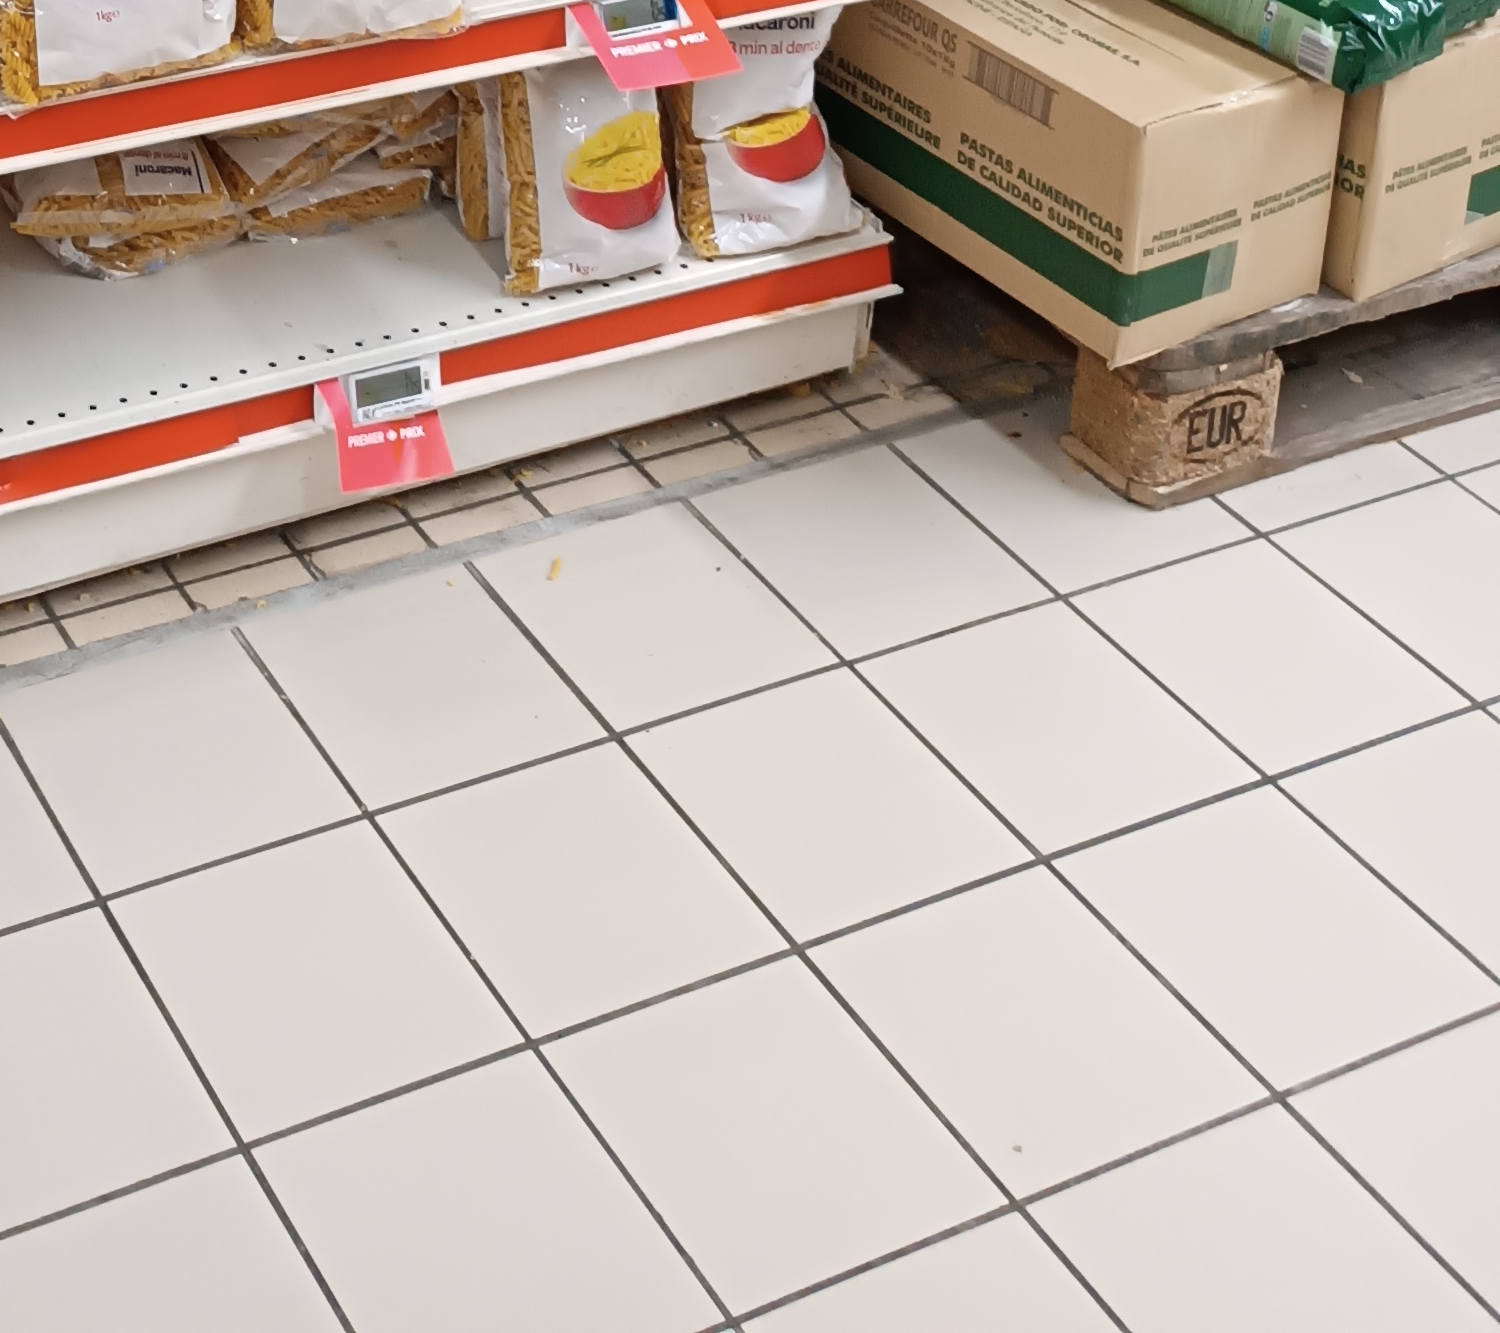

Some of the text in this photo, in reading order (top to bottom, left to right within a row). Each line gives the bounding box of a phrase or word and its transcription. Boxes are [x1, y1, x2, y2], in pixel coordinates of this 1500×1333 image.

[610, 31, 709, 58] PREMIER PRIX
[739, 39, 821, 55] min al dente
[837, 51, 932, 125] ALIMENTAIRES
[861, 89, 941, 151] SUPÉRIEURE
[134, 163, 192, 177] Macaroni
[959, 130, 1124, 244] PASTAS ALIMENTICIAS
[957, 150, 1124, 265] DE CALIDAD SUPERIOR
[1252, 192, 1283, 210] PASTAS
[1262, 198, 1296, 219] CALIDAD
[1179, 207, 1238, 235] ALIMENTAIRES
[348, 425, 425, 448] PREMIER PRIX
[1186, 402, 1246, 455] EUR
